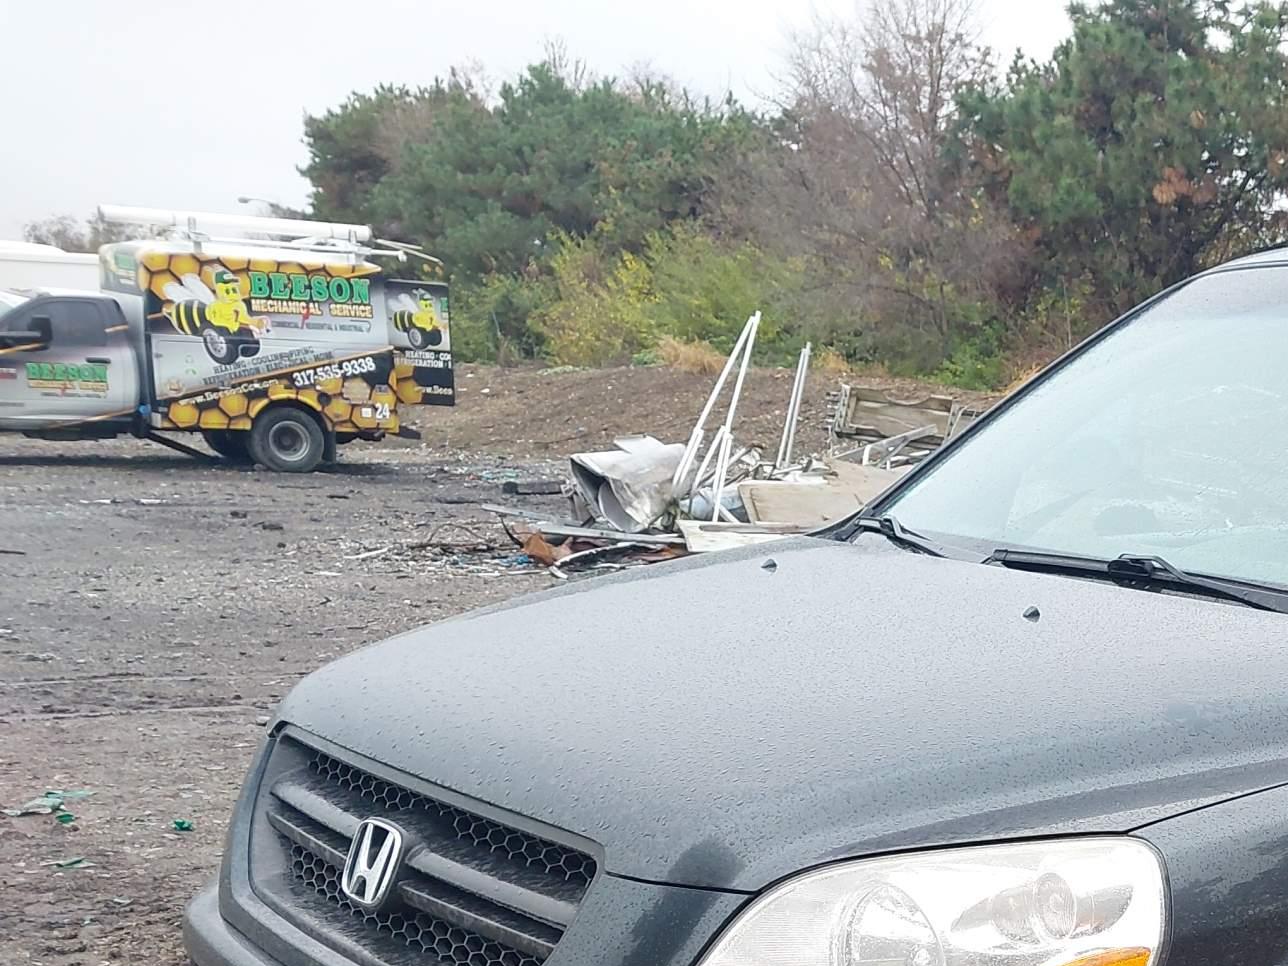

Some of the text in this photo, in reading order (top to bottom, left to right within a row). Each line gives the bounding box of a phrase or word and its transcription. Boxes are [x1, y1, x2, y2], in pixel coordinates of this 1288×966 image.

[249, 271, 370, 304] BEESON
[251, 299, 372, 318] MECHANICAL SERVICE
[26, 362, 108, 383] BEESON
[292, 357, 377, 387] 317-535-9338
[375, 402, 391, 420] 24
